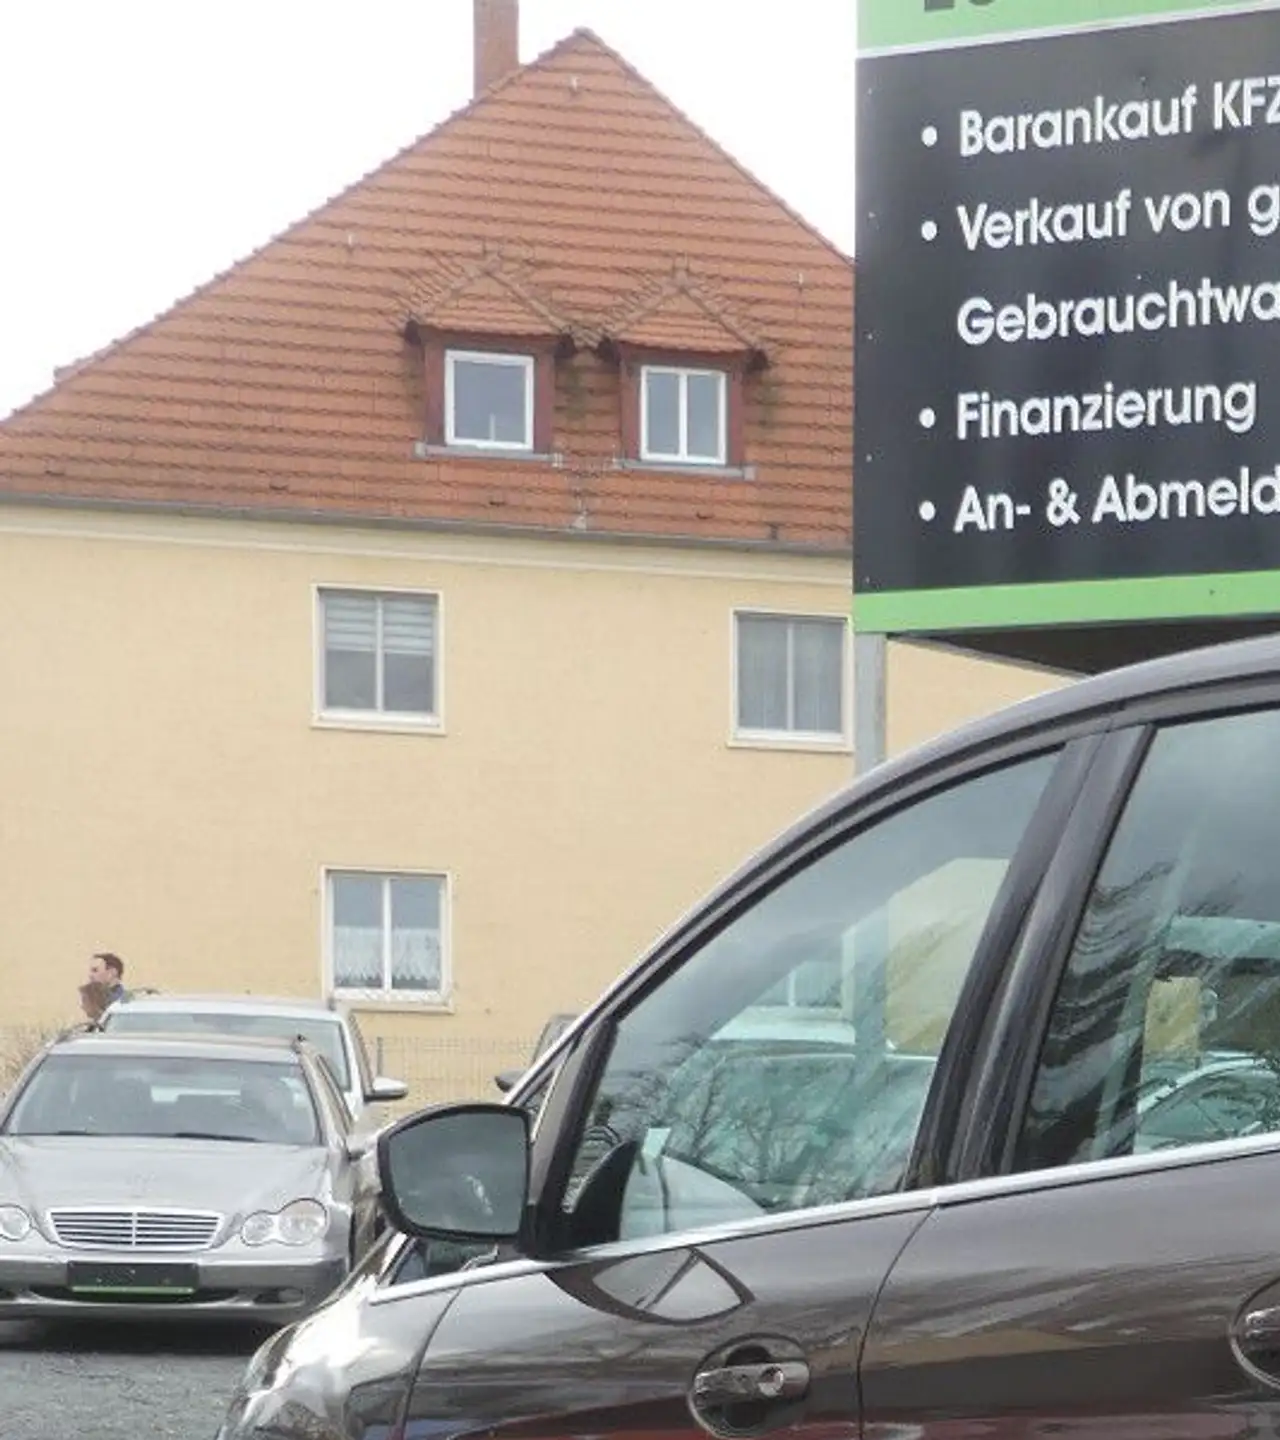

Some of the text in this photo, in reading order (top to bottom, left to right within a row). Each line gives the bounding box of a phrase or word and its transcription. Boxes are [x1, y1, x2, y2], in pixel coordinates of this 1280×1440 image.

[958, 82, 1199, 158] Barankauf
[955, 187, 1133, 251] Verkauf
[1143, 188, 1231, 235] von
[956, 381, 1258, 440] Finanzierung
[953, 485, 1032, 534] An-
[1046, 477, 1081, 527] &
